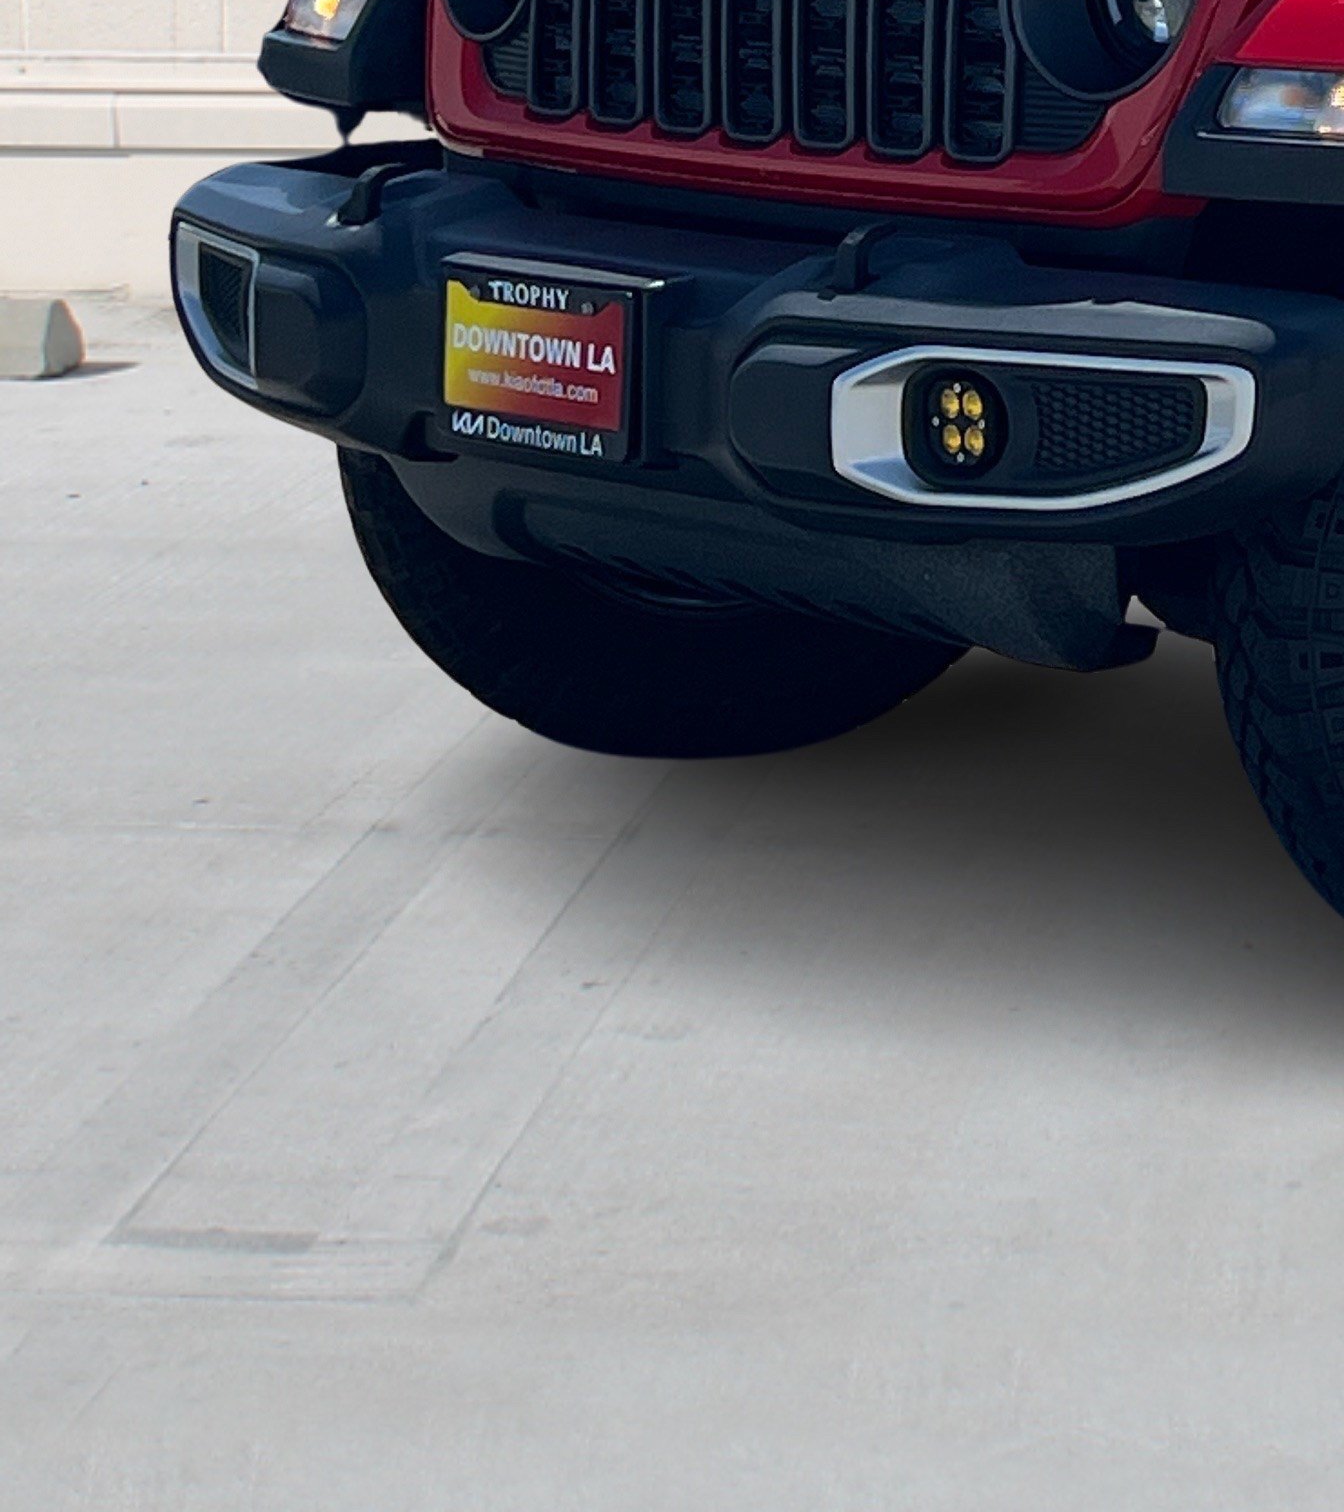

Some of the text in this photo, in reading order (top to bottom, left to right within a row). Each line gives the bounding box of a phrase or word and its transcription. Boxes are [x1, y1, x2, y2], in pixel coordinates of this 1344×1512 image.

[488, 281, 569, 310] TROPHY
[452, 323, 616, 375] DOWNTOWN LA
[486, 415, 578, 454] Downtown
[580, 432, 603, 458] LA
